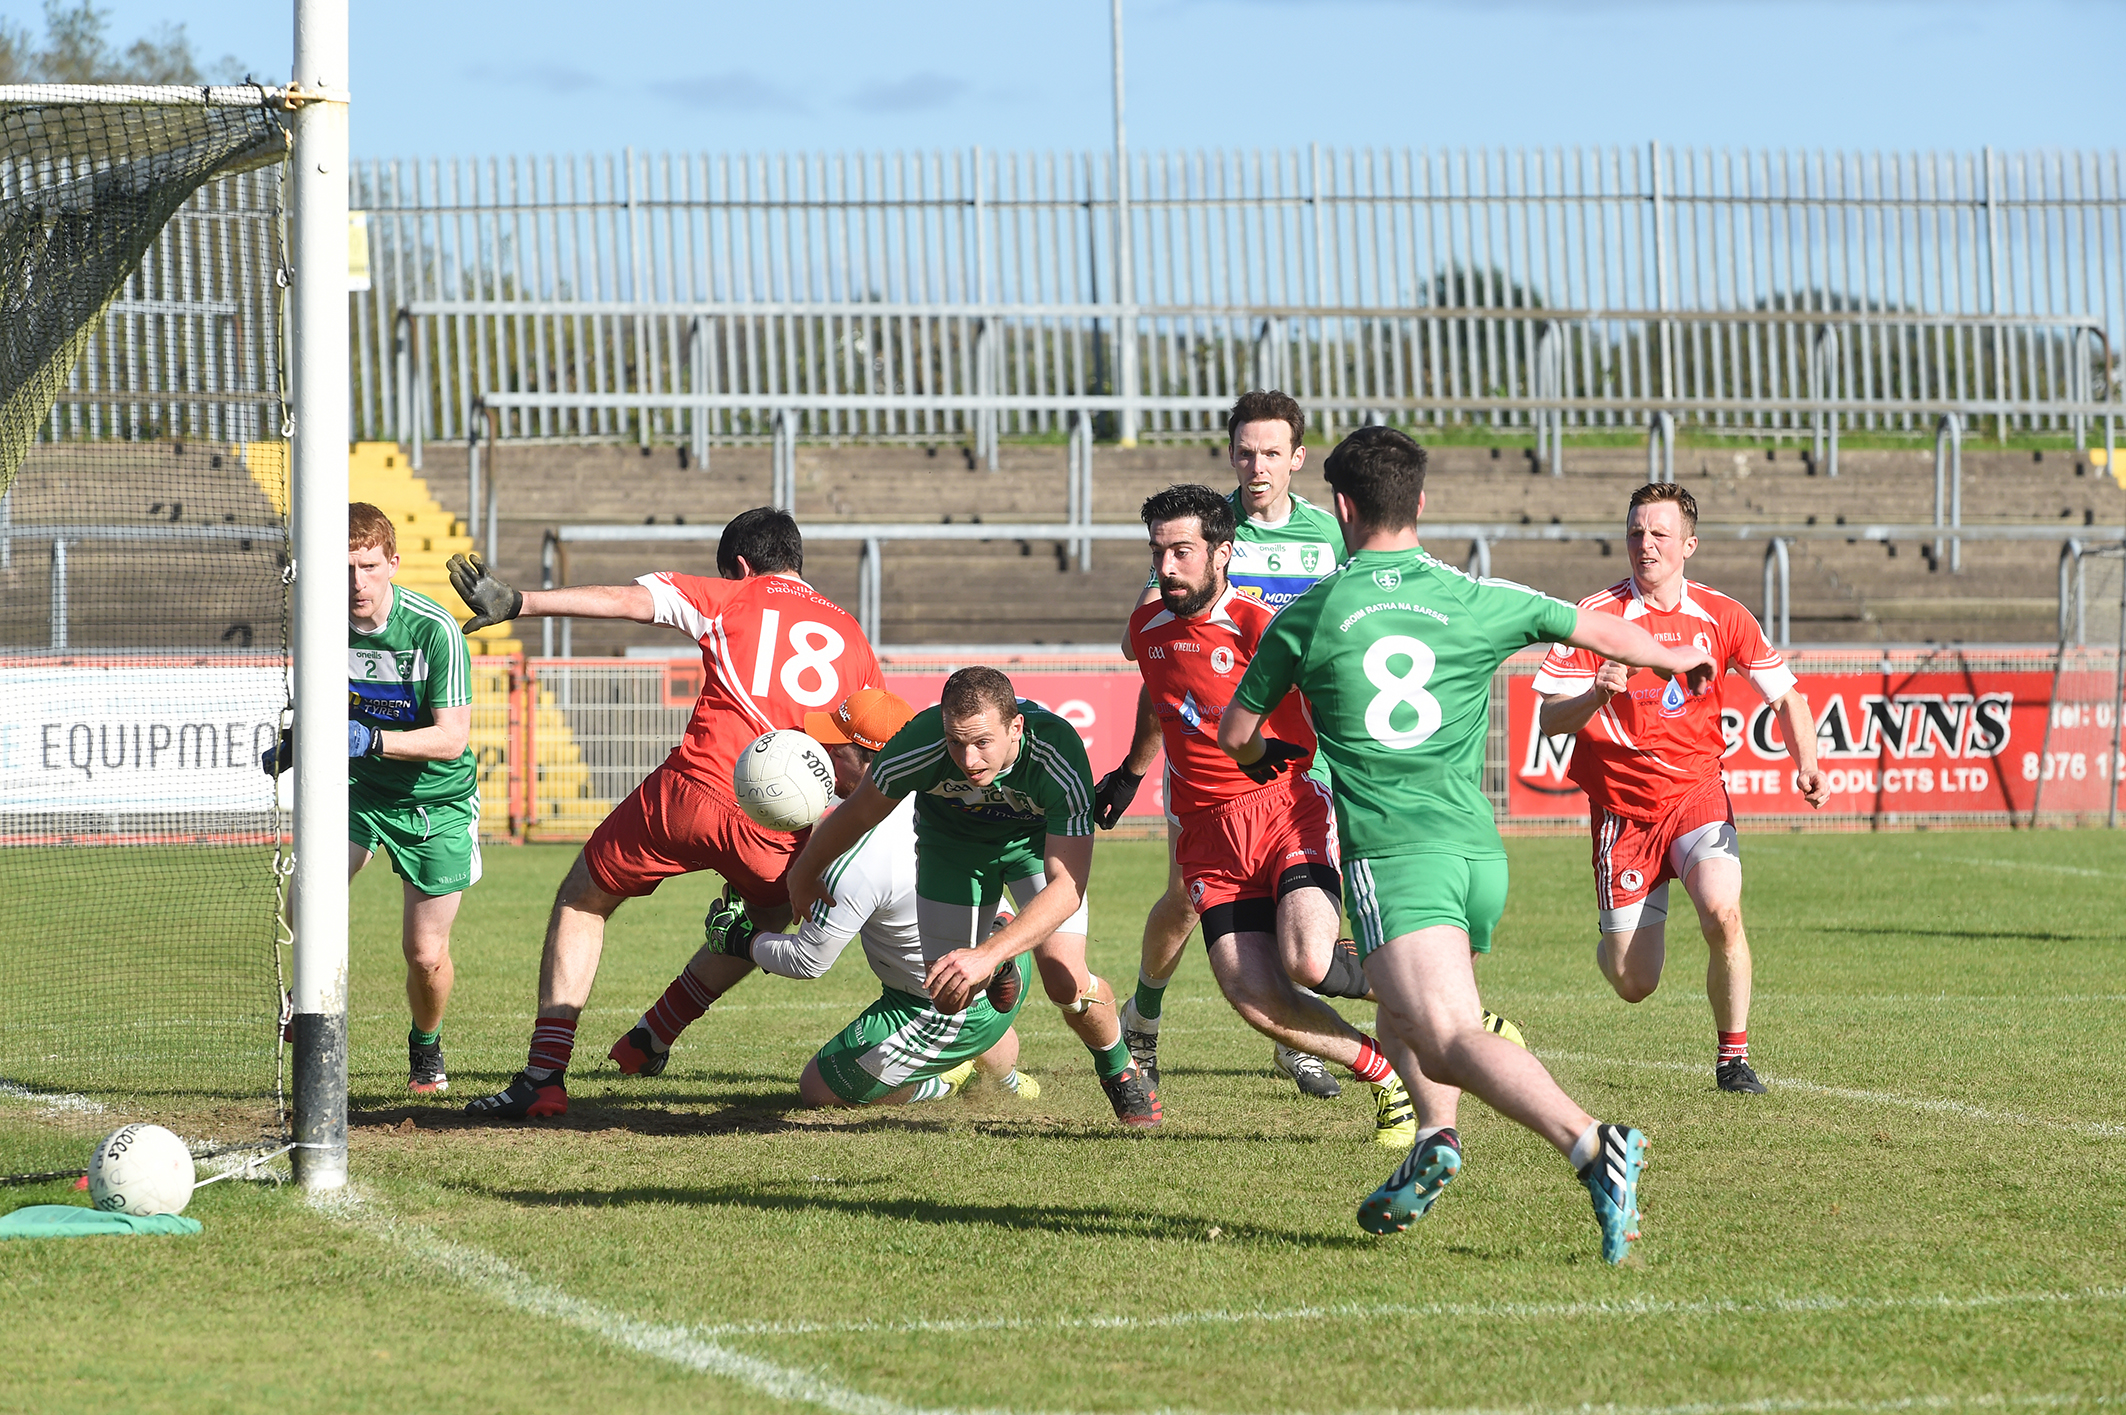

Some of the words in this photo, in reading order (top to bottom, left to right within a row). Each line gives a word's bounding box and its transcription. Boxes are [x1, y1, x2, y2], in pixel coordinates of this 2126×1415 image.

[1267, 553, 1281, 572] 6
[1339, 608, 1366, 633] DROIM
[1365, 602, 1398, 614] RATHA
[1398, 602, 1412, 611] NA
[364, 659, 378, 679] 2
[751, 608, 845, 708] 18
[1363, 635, 1442, 750] 8
[365, 704, 400, 718] TYRES
[1940, 767, 1989, 793] LTD
